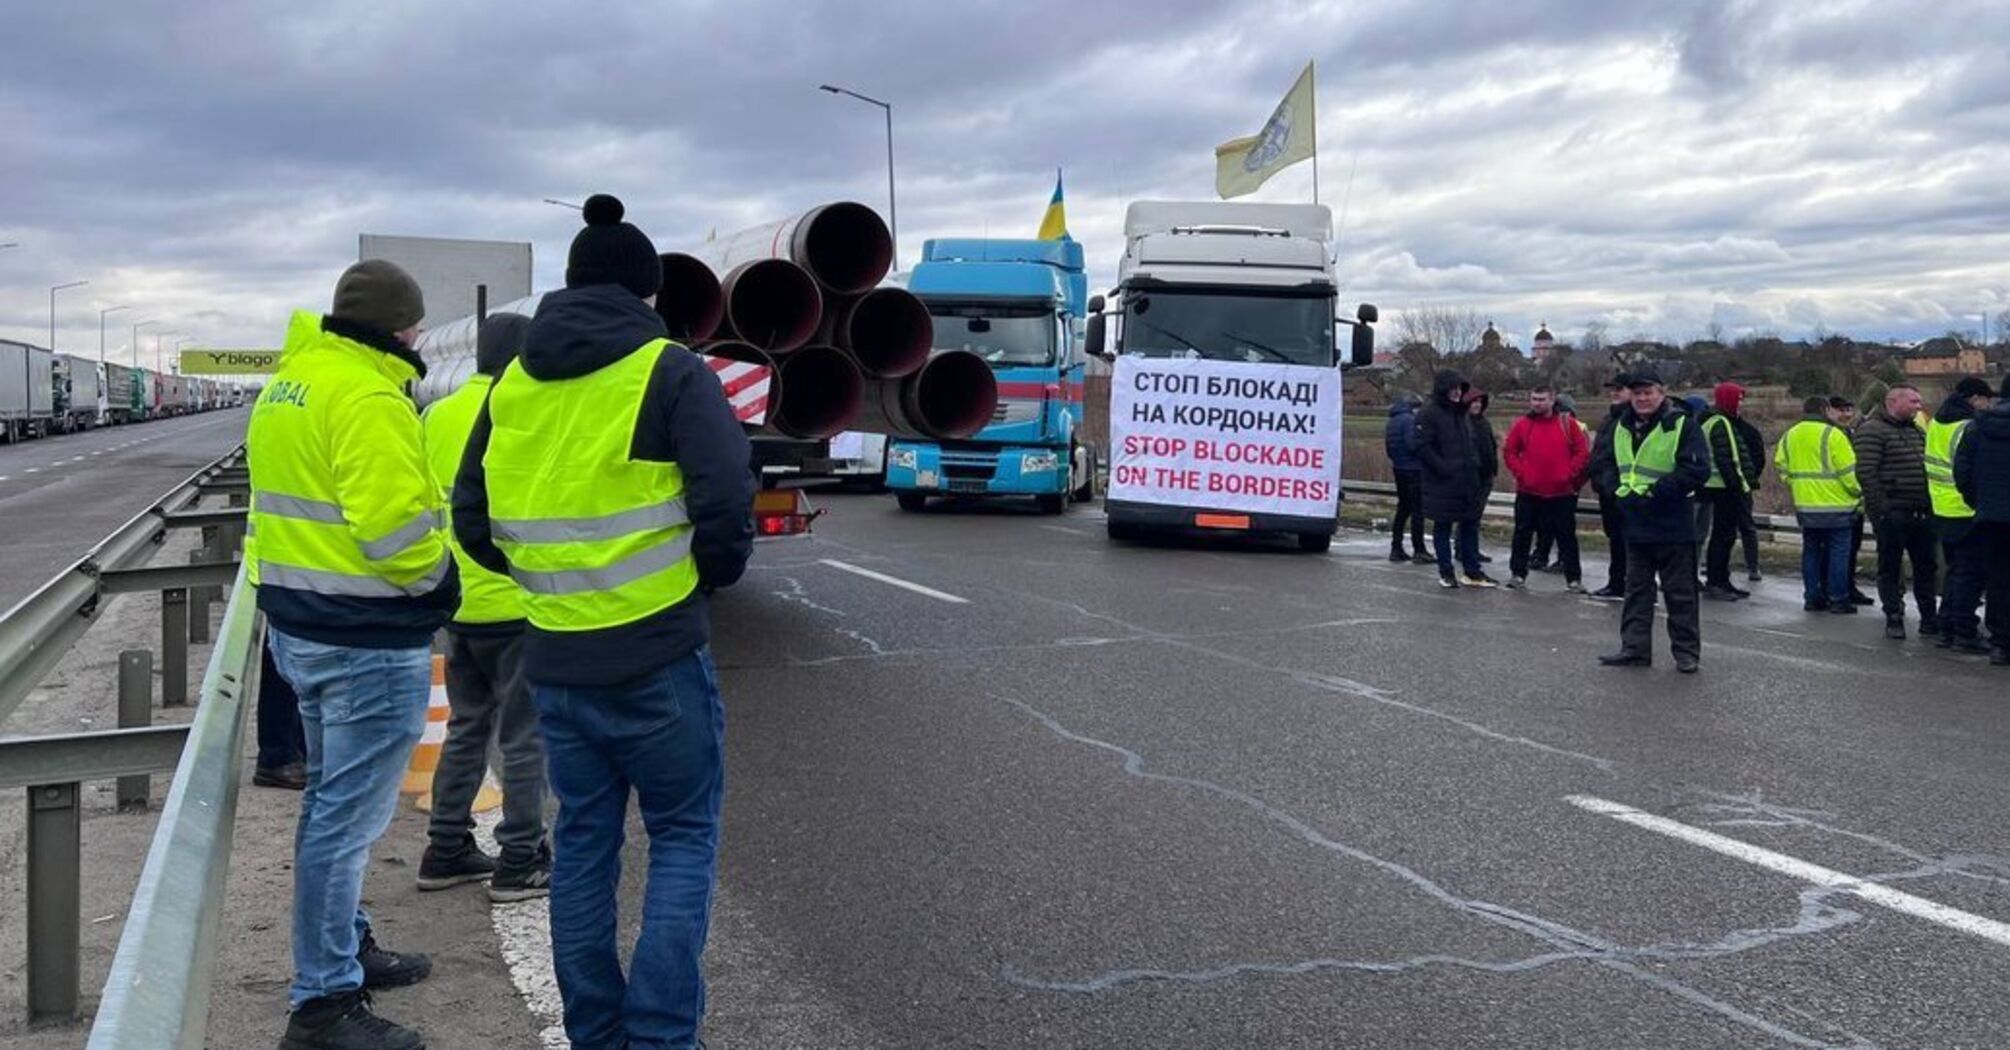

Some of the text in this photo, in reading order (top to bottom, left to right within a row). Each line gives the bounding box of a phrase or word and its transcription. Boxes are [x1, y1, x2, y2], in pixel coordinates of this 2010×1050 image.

[228, 353, 273, 368] blago
[260, 381, 311, 407] OBAL
[1134, 372, 1318, 407] СТОП БЛОКАДІ
[1132, 403, 1316, 434] НА КОРДОНАХ!
[1124, 436, 1325, 469] STOP BLOCKADE
[1116, 465, 1330, 500] ON THE BORDERS!
